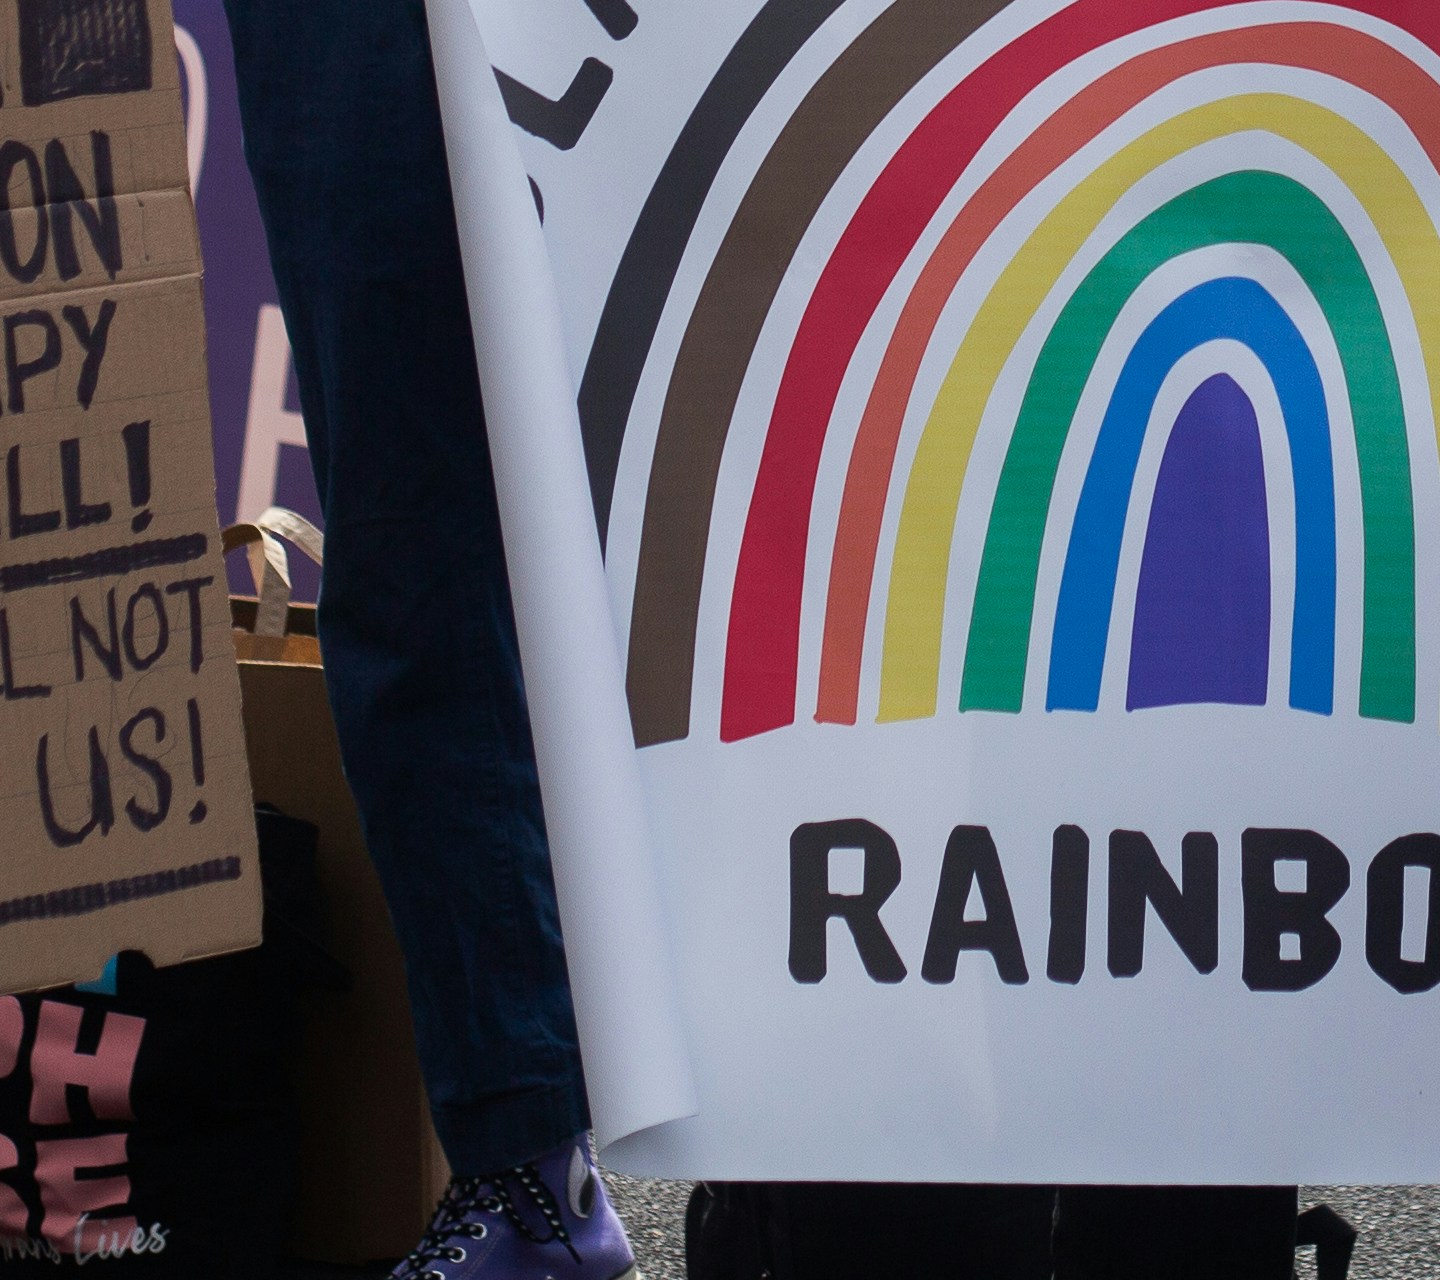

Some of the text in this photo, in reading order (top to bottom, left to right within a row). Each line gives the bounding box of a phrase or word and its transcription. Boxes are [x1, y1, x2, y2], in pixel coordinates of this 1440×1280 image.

[70, 575, 214, 683] NOT
[36, 698, 208, 849] US!
[72, 1211, 171, 1267] Lives
